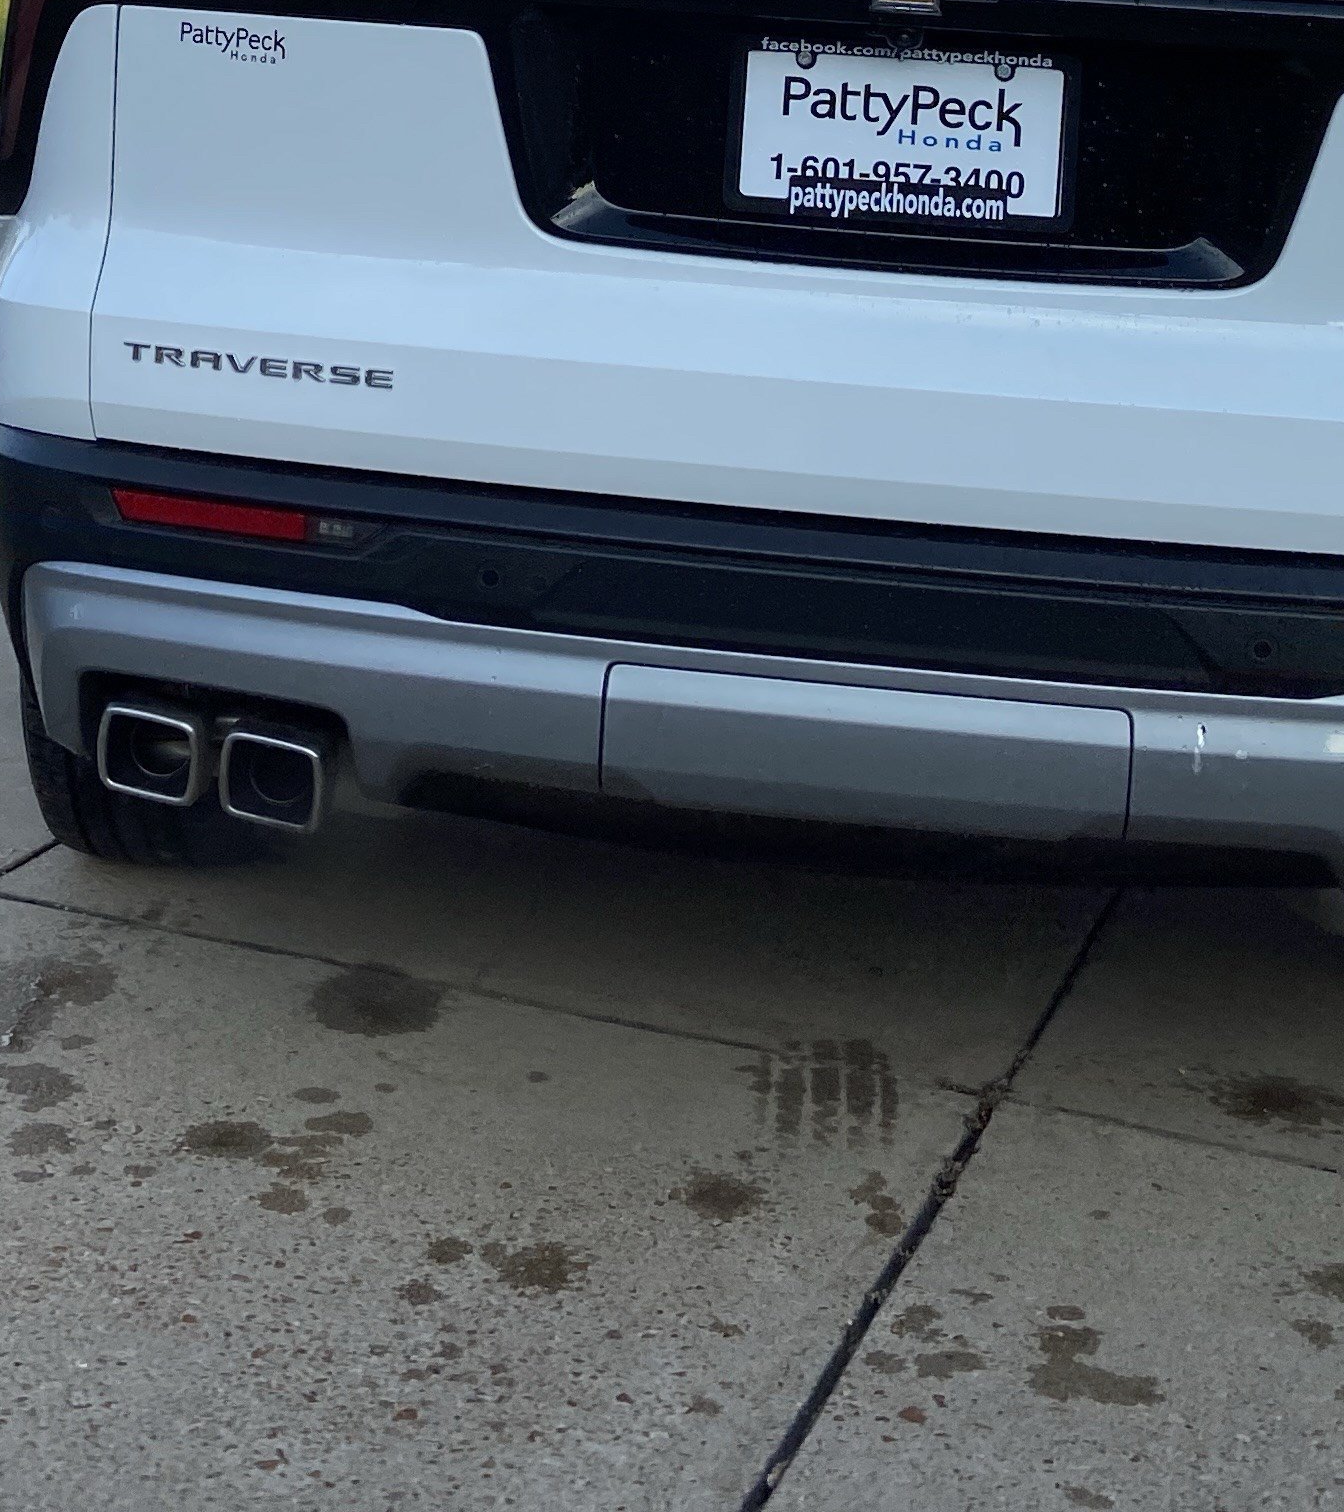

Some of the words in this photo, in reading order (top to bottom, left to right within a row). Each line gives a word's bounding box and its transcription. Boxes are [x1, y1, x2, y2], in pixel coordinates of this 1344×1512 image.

[180, 21, 286, 60] PattyPeck
[230, 50, 276, 64] Honda
[782, 75, 1023, 148] PattyPeck
[898, 129, 1003, 153] Honda
[770, 153, 1025, 199] 1-601-957-3400
[789, 183, 1004, 220] pattypeckhonda.com
[123, 341, 394, 389] TRAVERSE
